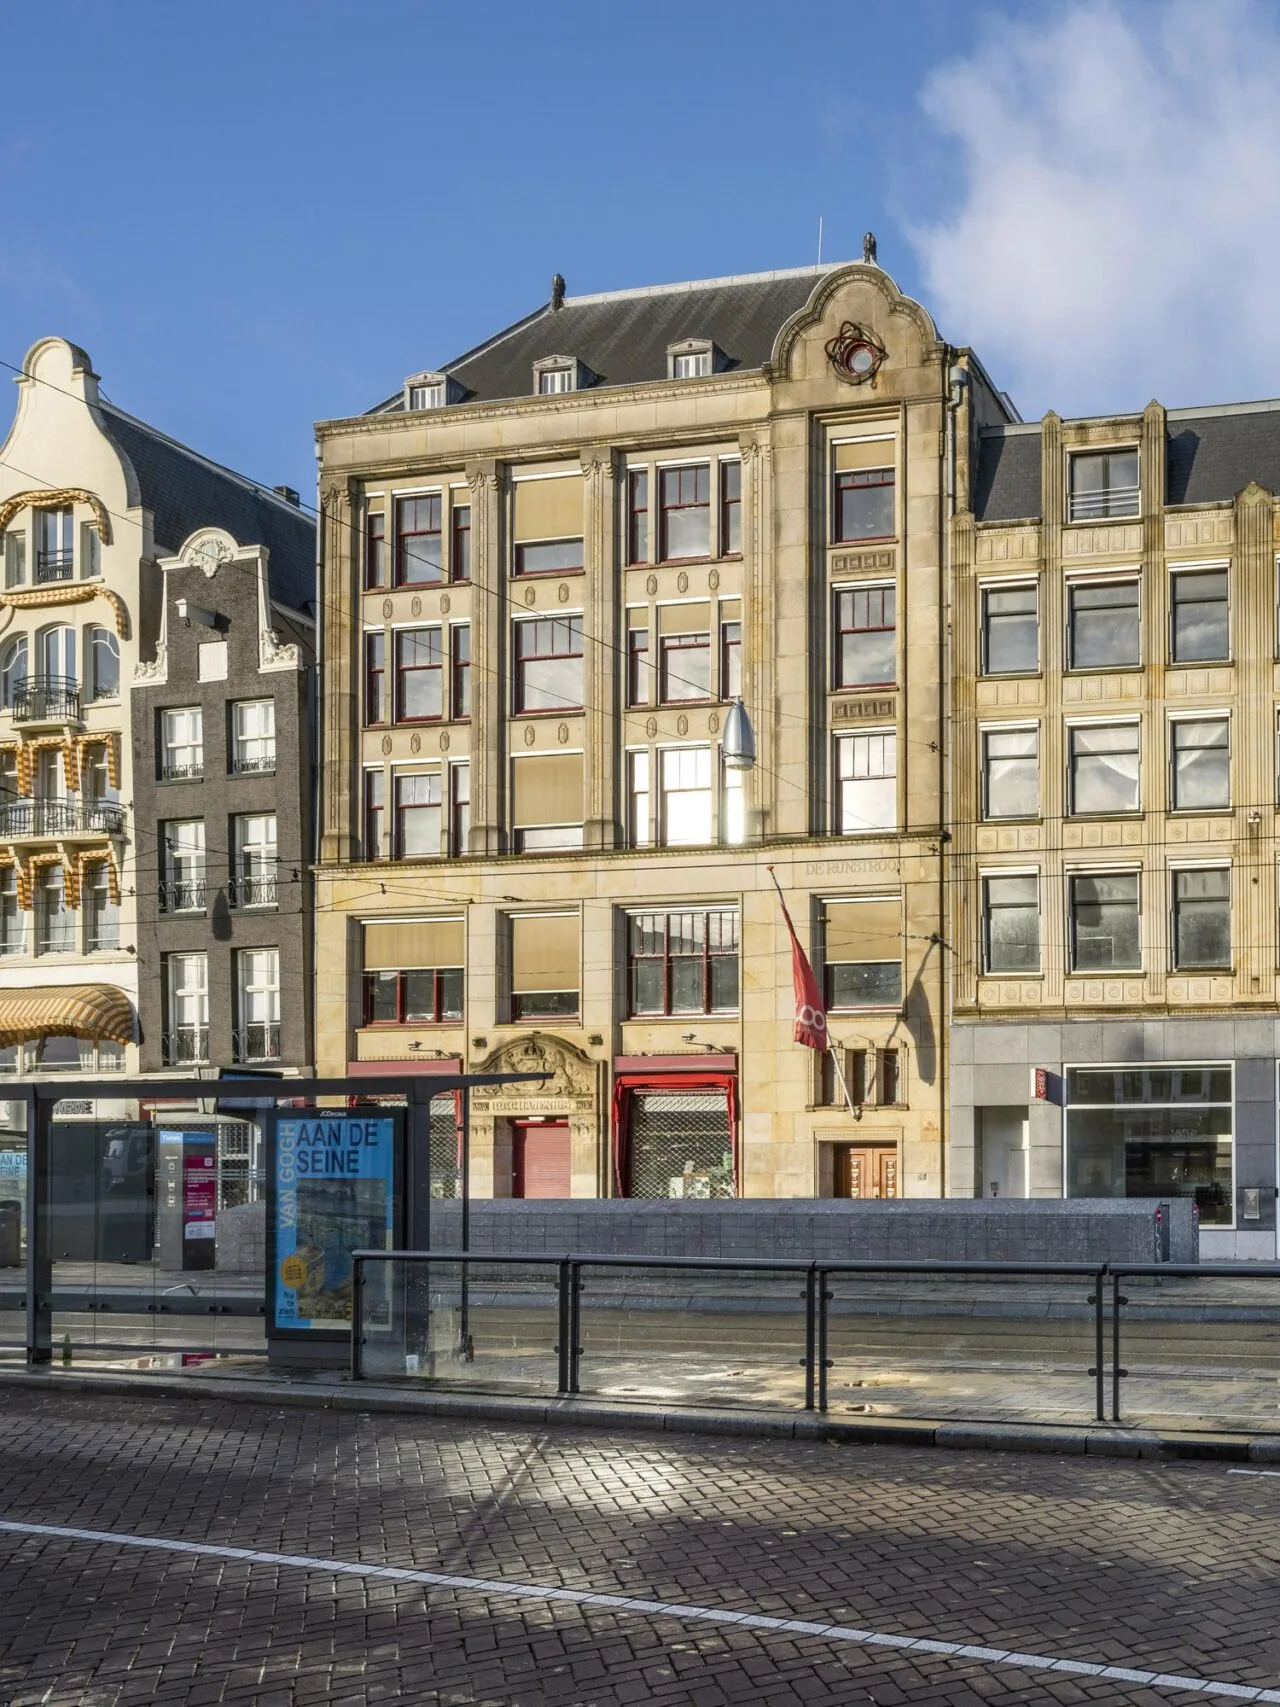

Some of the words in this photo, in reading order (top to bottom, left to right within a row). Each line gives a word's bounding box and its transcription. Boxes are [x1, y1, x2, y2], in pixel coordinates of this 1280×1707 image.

[806, 862, 824, 875] DE
[296, 1123, 341, 1146] AAN
[349, 1123, 378, 1146] DE
[0, 1154, 13, 1165] AN
[16, 1154, 27, 1165] DE
[279, 1123, 296, 1183] GOGH
[296, 1149, 360, 1173] SEINE
[0, 1166, 20, 1176] EINE
[279, 1189, 296, 1228] VAN
[283, 1291, 295, 1299] Nu
[278, 1307, 295, 1315] zien
